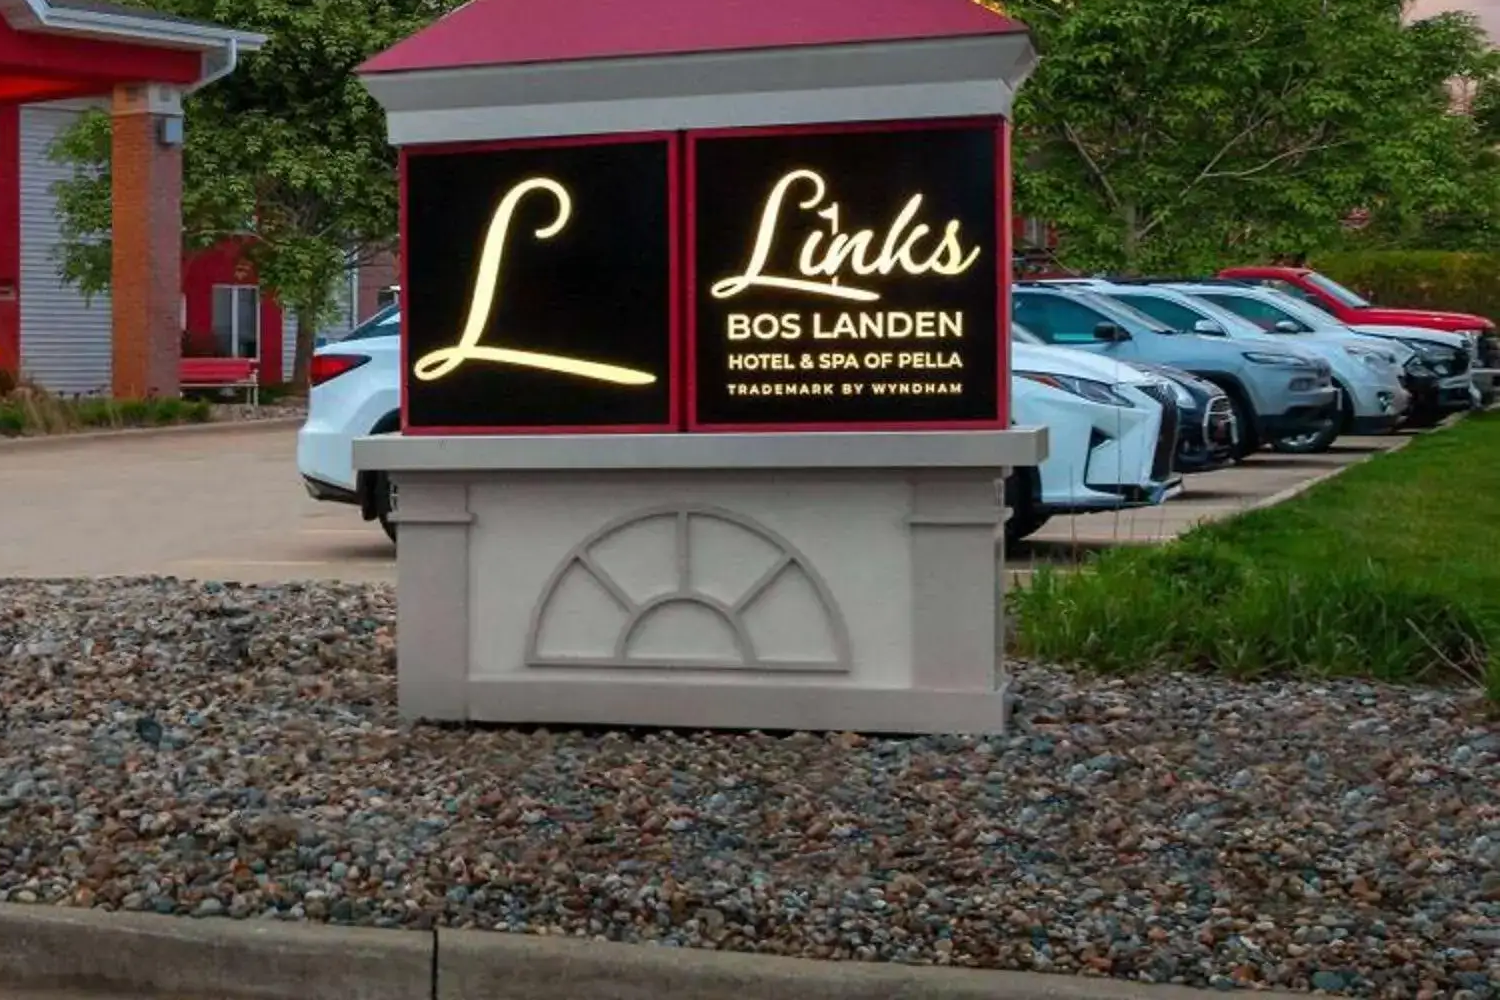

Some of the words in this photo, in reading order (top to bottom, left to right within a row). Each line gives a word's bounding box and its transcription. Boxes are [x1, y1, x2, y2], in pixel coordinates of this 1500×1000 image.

[711, 169, 981, 301] Links
[414, 177, 657, 385] L
[727, 313, 802, 340] BOS
[813, 311, 963, 339] LANDEN
[728, 353, 796, 370] HOTEL
[799, 353, 815, 369] &
[819, 353, 860, 369] SPA
[863, 352, 893, 369] OF
[898, 351, 963, 369] PELLA
[727, 383, 834, 395] TRADEMARK
[842, 383, 864, 395] BY
[871, 383, 962, 394] WYNDHAM
